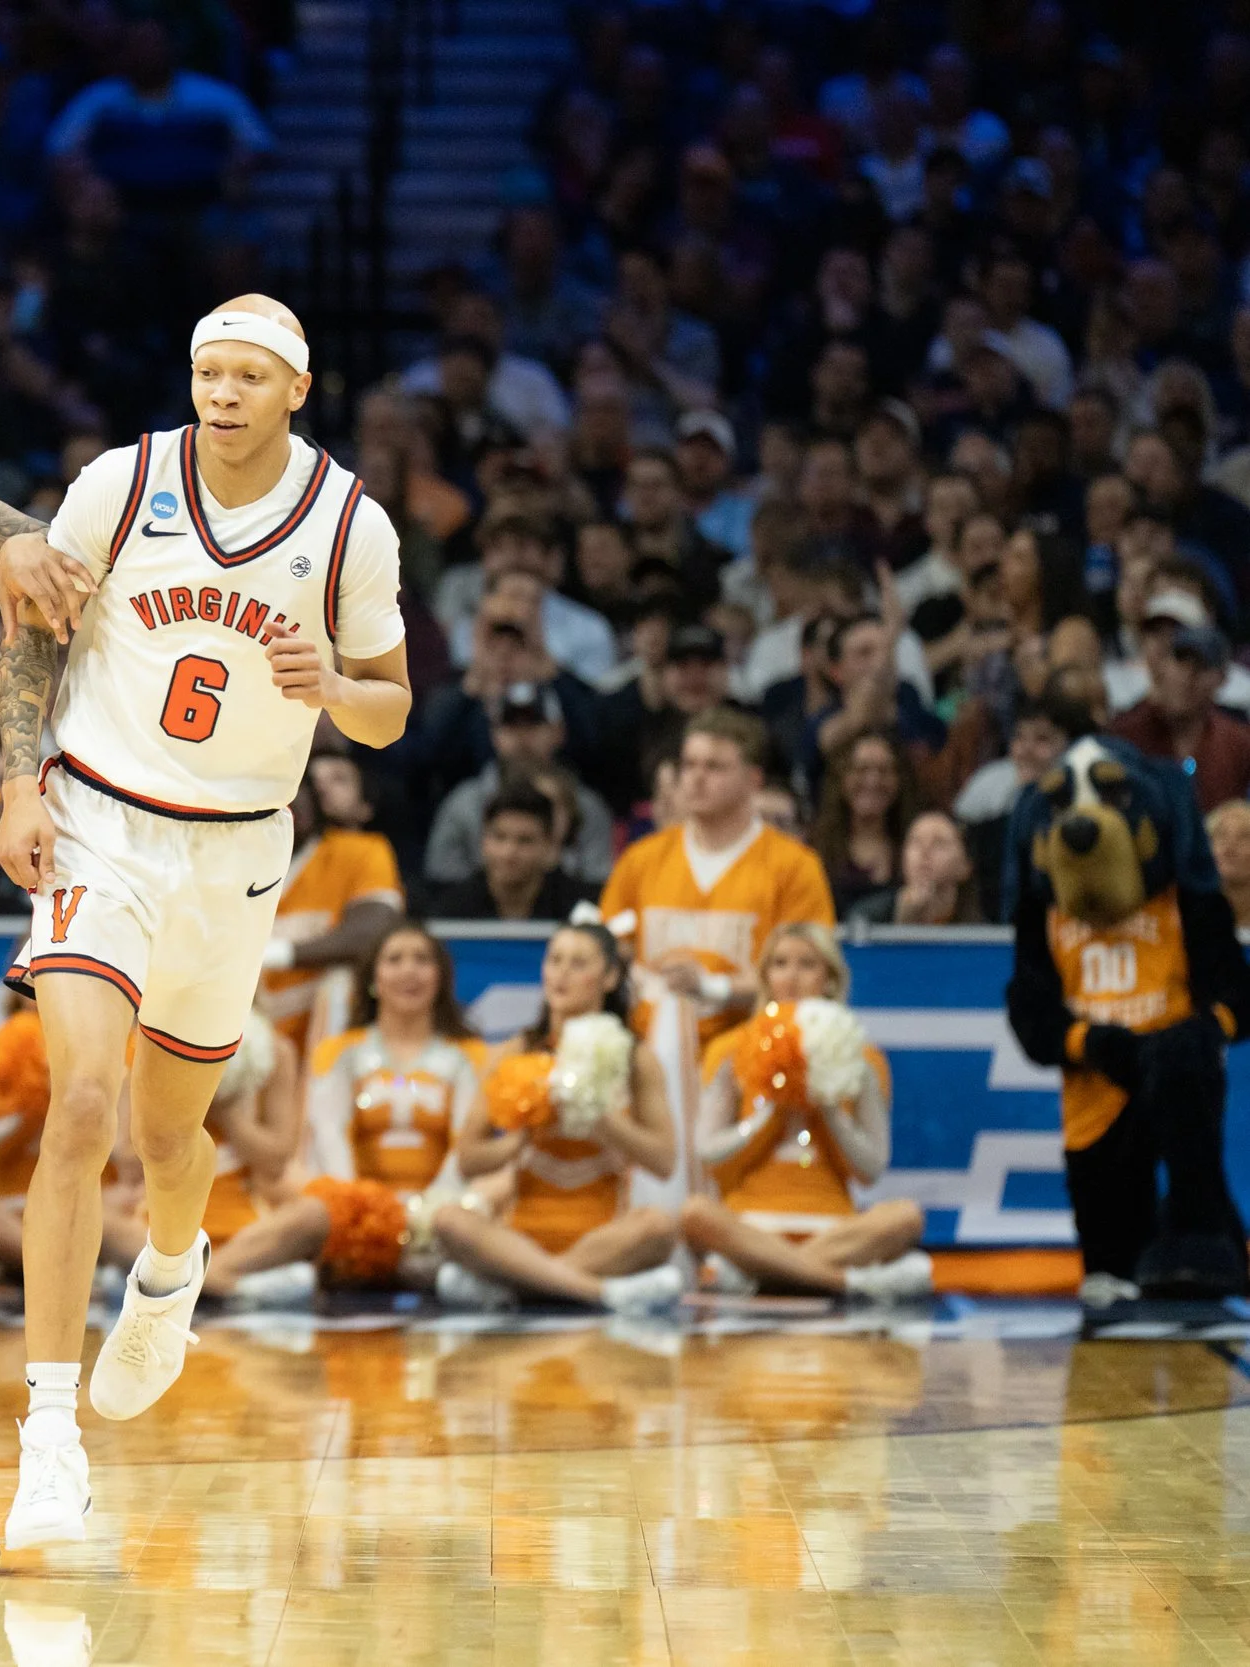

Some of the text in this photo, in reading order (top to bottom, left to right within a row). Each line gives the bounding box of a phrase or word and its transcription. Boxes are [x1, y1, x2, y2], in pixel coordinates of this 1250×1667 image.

[152, 502, 176, 515] NCAA
[129, 587, 301, 646] VIRGINI
[159, 653, 229, 743] 6
[51, 885, 88, 943] V
[1082, 941, 1137, 994] 00
